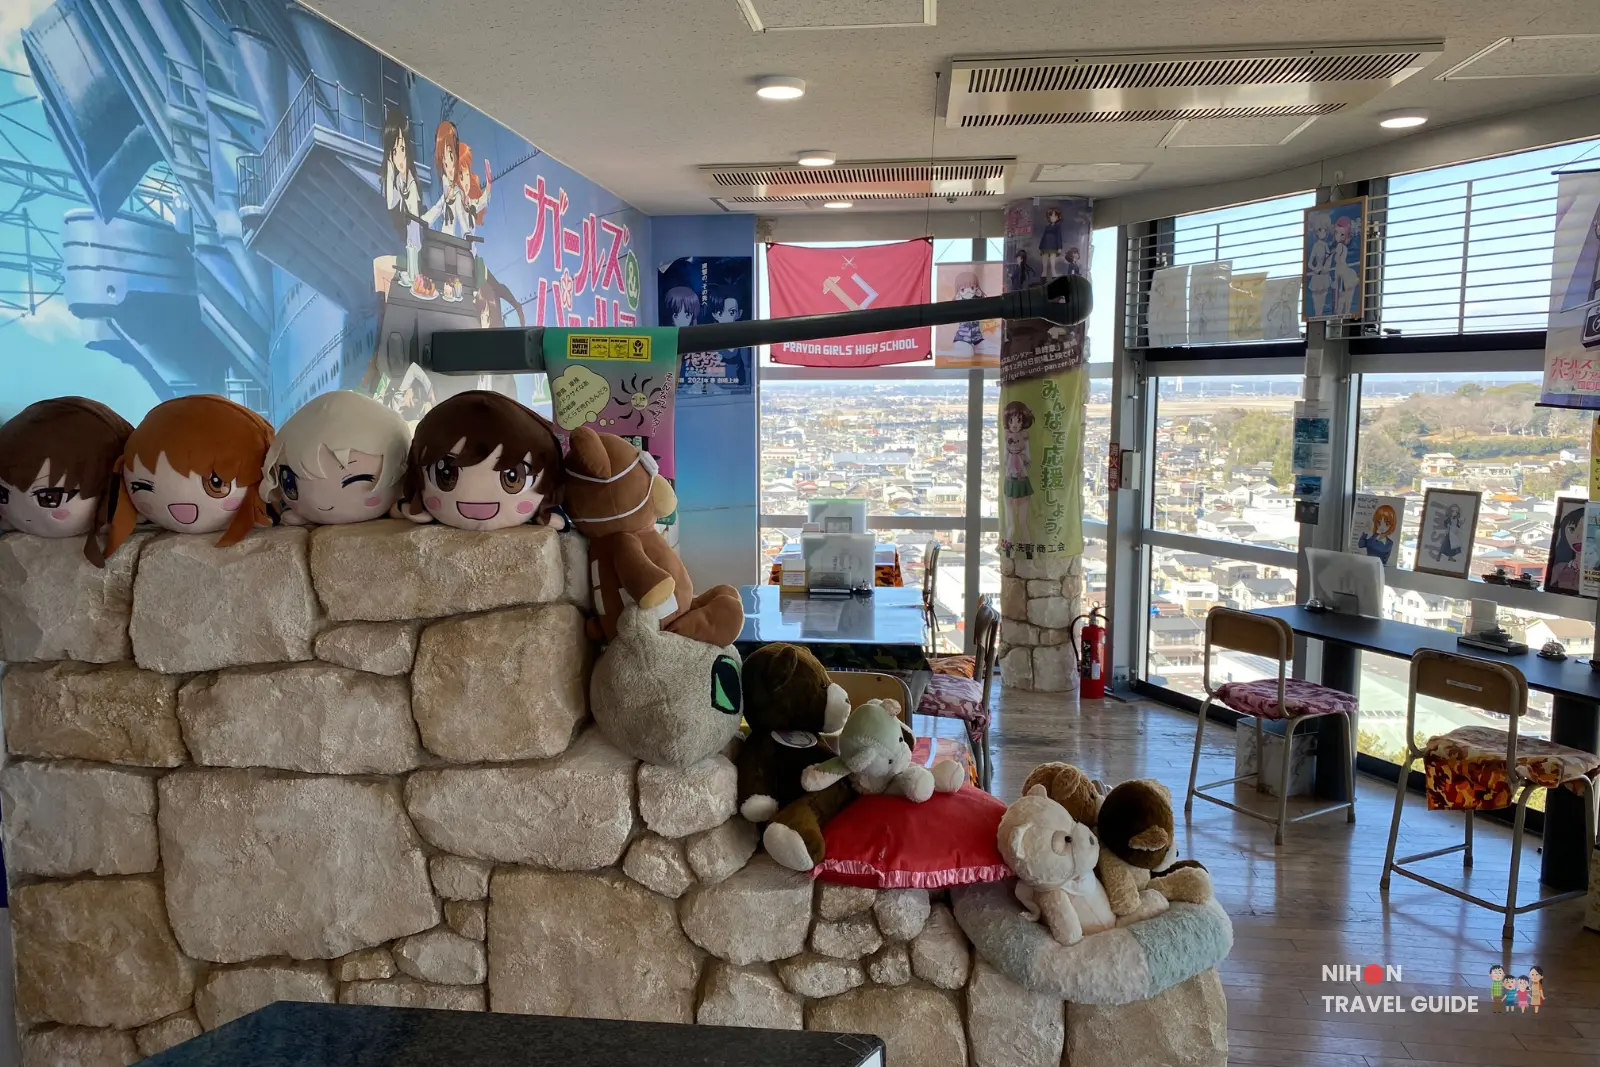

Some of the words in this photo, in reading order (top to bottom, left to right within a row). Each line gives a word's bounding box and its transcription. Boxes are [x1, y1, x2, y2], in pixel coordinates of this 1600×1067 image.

[783, 342, 823, 354] PRAVDA
[855, 341, 878, 355] HIGH
[879, 337, 918, 350] SCHOOL
